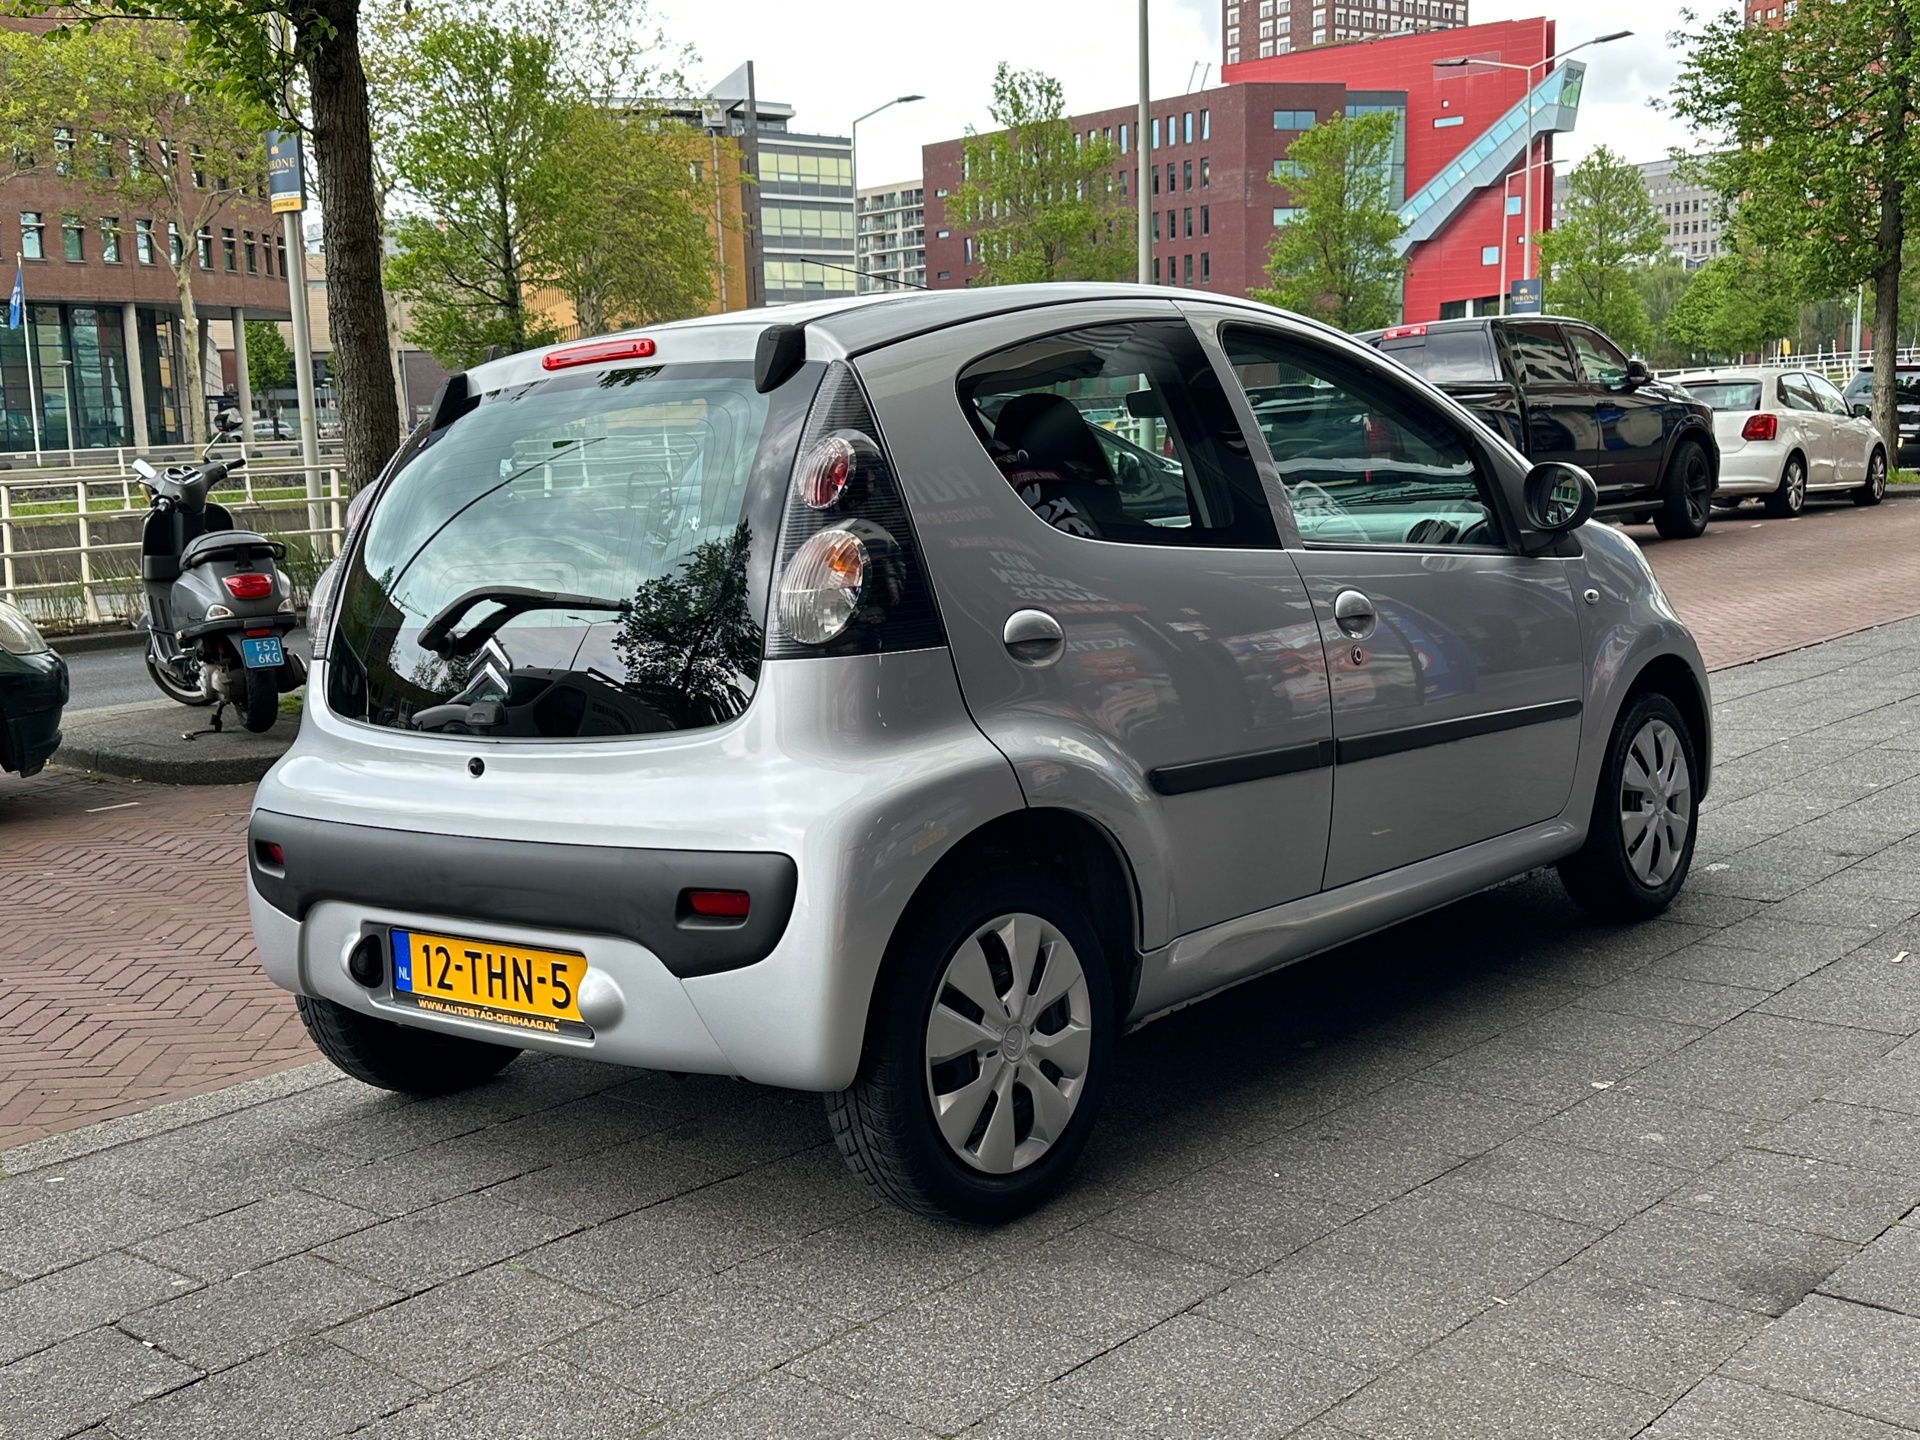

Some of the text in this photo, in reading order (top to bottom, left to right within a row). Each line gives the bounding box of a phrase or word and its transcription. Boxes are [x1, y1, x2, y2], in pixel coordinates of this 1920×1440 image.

[255, 640, 278, 652] F52
[258, 652, 281, 664] 6KG
[398, 966, 411, 981] NL
[421, 943, 572, 1010] 12-THN-5
[418, 998, 560, 1033] WWW.AUTOSTAD-DENHAAG.NL
